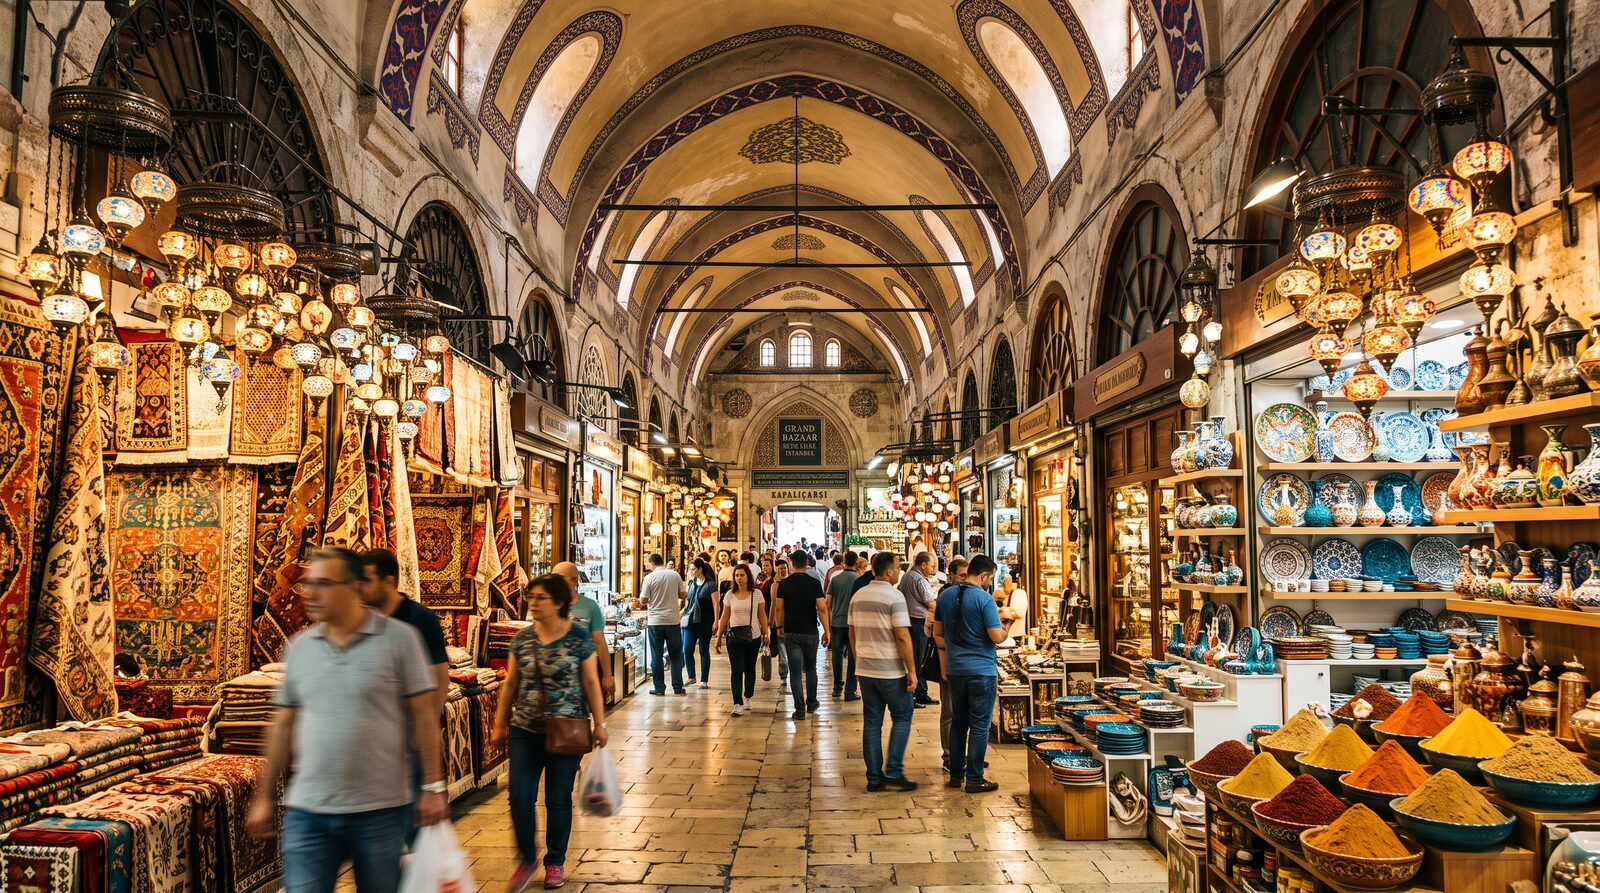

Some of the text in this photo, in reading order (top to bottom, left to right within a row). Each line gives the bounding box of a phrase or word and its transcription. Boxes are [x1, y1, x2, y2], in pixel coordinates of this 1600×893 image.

[784, 424, 815, 433] GRAND
[782, 433, 818, 442] BAZAAR
[771, 491, 828, 500] KAPALIÇARŞI
